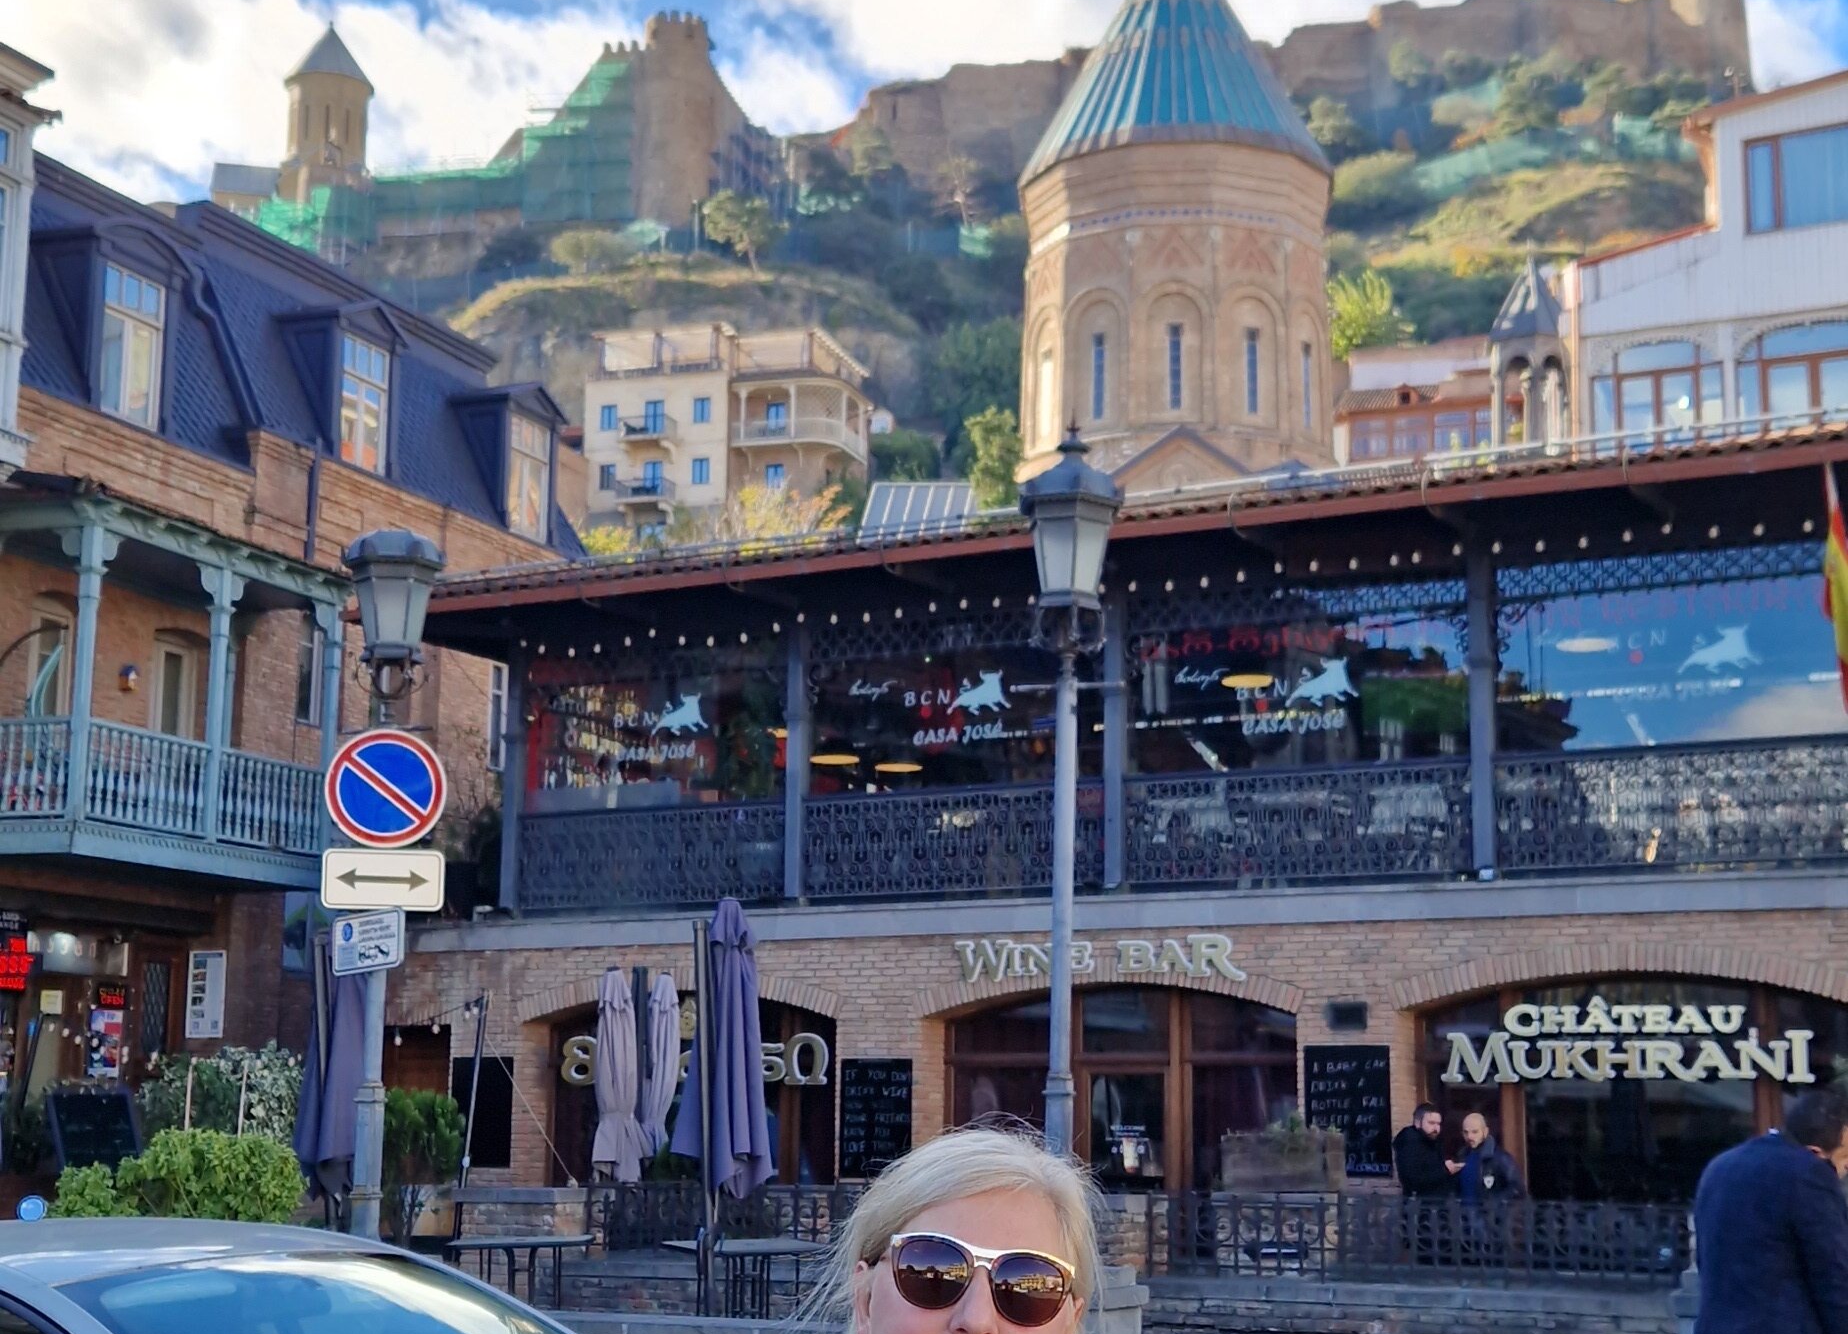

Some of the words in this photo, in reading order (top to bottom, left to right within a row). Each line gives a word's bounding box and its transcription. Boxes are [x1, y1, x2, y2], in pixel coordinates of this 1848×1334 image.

[913, 727, 957, 746] CASA
[1242, 717, 1291, 736] CASA
[954, 939, 1095, 983] WINE
[1116, 934, 1246, 982] BAR
[1503, 995, 1747, 1037] CHÂTEAU
[1440, 1028, 1816, 1084] MUKHRANI
